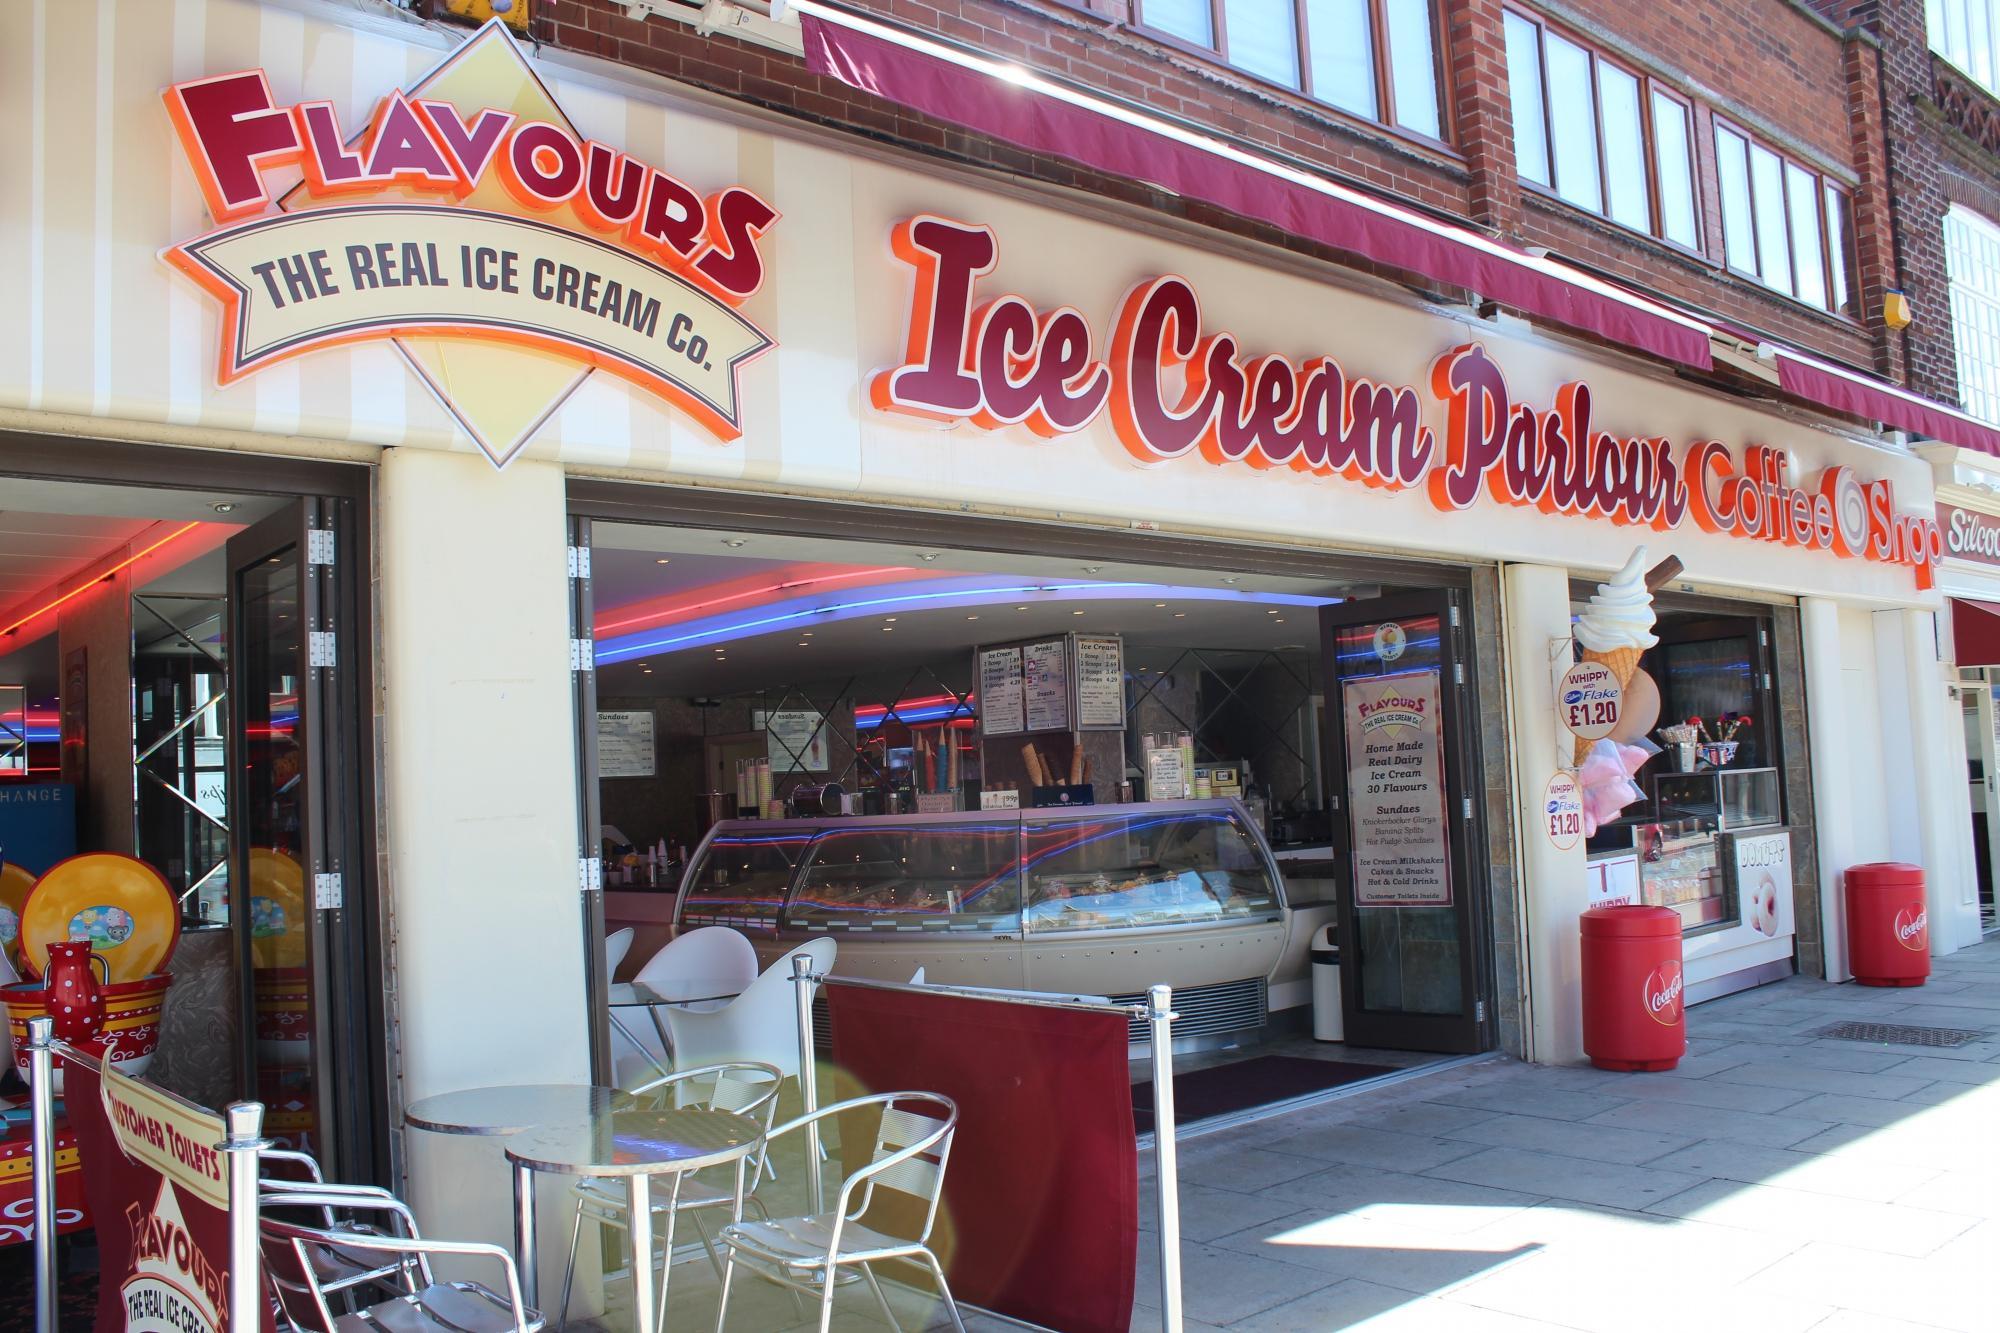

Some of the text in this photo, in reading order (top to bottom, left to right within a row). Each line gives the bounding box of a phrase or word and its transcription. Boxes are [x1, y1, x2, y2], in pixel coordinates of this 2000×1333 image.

[252, 241, 713, 372] THE REAL ICE CREAM Co.
[872, 214, 1944, 590] Ice Cream Parlour Coffee Shop
[1569, 670, 1609, 684] WHIPPY
[1584, 689, 1618, 700] Flake
[1358, 697, 1426, 718] FLAVOURS
[1570, 701, 1617, 727] £1.20
[1365, 741, 1424, 754] Home Made
[1368, 755, 1423, 766] Real Dairy
[1371, 770, 1422, 780] Ice Cream
[1367, 783, 1428, 794] 30 Flavours
[1550, 784, 1575, 794] WHIPPY
[1376, 805, 1421, 815] Sundaes
[1551, 813, 1580, 836] £1.20
[1741, 840, 1785, 868] DONUTS
[1360, 857, 1444, 866] Ice Cream Milkshakes
[1371, 868, 1394, 876] Cakes
[1405, 867, 1434, 875] Snacks
[1368, 878, 1381, 886] Hot
[1393, 878, 1410, 886] Cold
[1412, 877, 1439, 885] Drinks
[165, 1121, 221, 1181] TOILETS
[128, 1291, 144, 1322] THE
[143, 1289, 164, 1320] REAL
[166, 1294, 180, 1328] ICE
